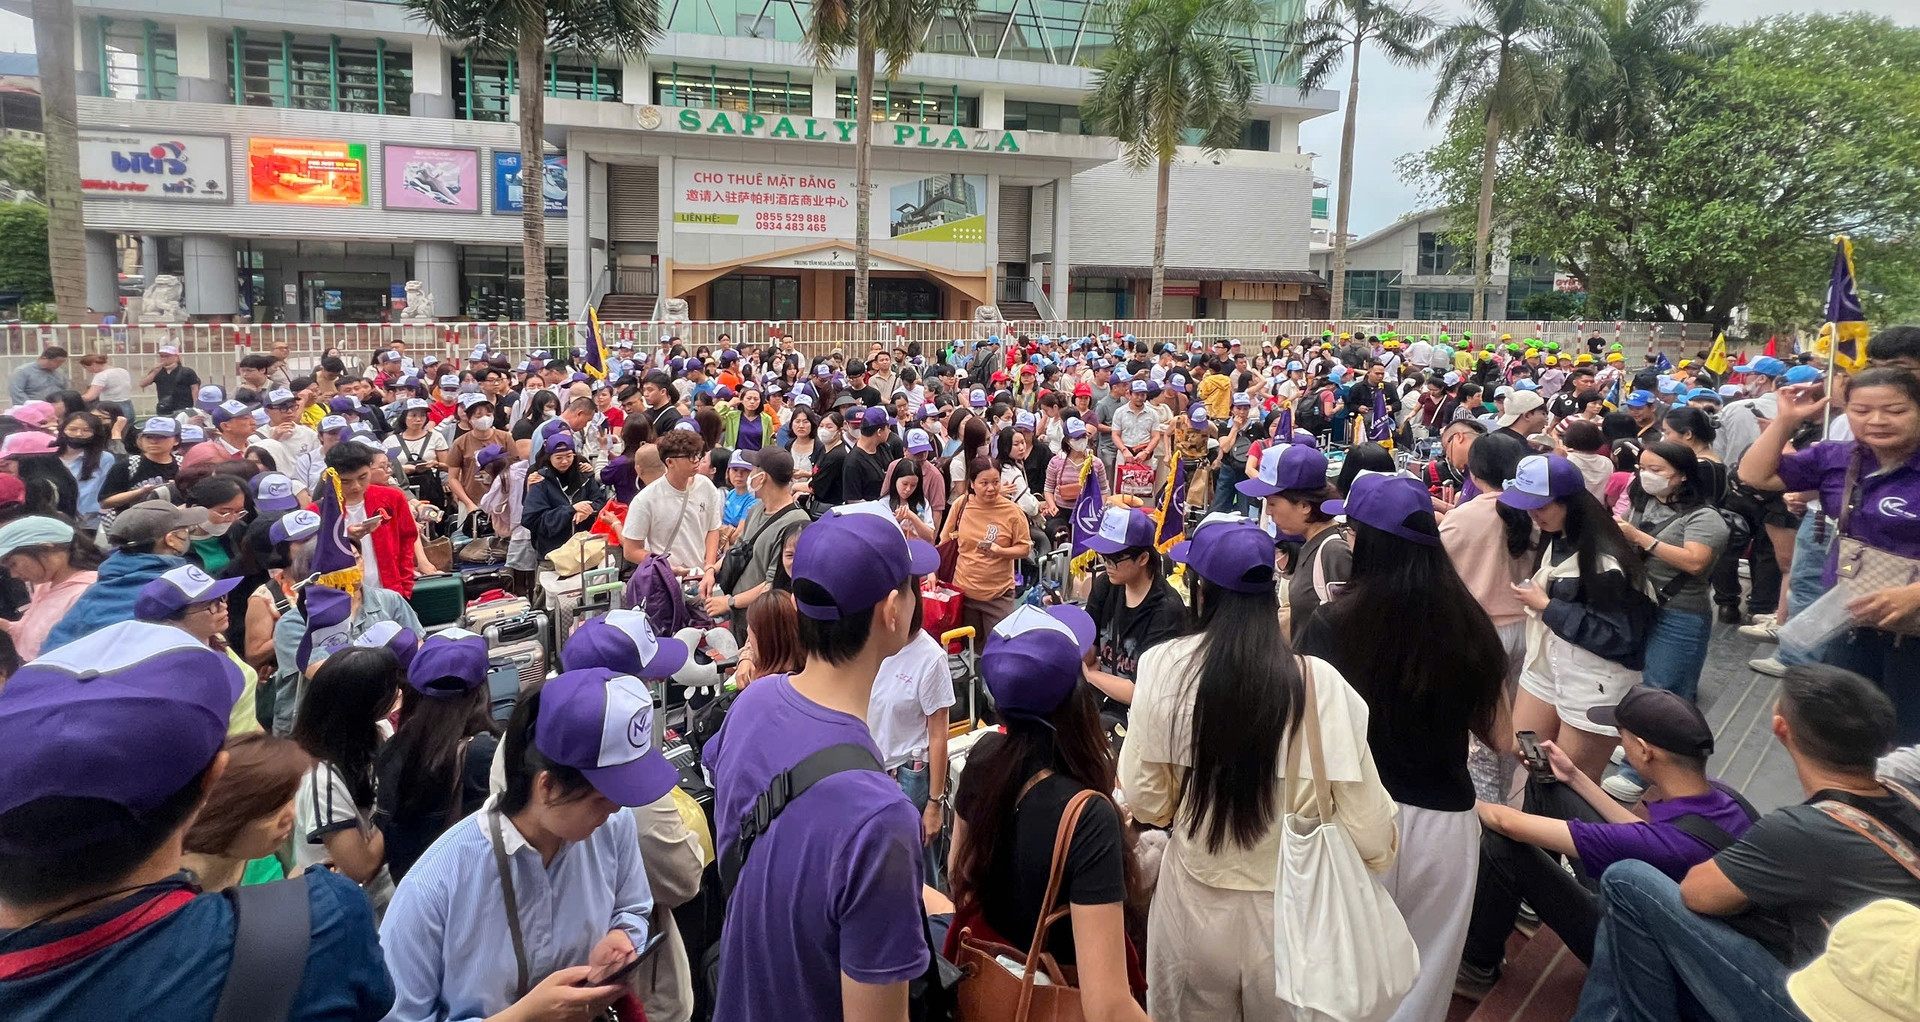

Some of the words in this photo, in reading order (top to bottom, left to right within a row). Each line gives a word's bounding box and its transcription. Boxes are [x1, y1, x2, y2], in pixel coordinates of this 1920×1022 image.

[678, 109, 857, 141] SAPALY
[893, 124, 1019, 152] PLAZA
[694, 172, 723, 183] CHO
[727, 172, 763, 186] THUÊ
[767, 173, 795, 189] MẶT
[686, 189, 849, 208] 邀请入驻萨帕利酒店商业中心
[681, 213, 702, 222] LIÊN
[756, 212, 782, 221] 0855
[785, 213, 804, 222] 529
[806, 214, 826, 223] 888
[756, 221, 782, 230] 0934
[785, 222, 804, 231] 483
[807, 223, 827, 232] 465
